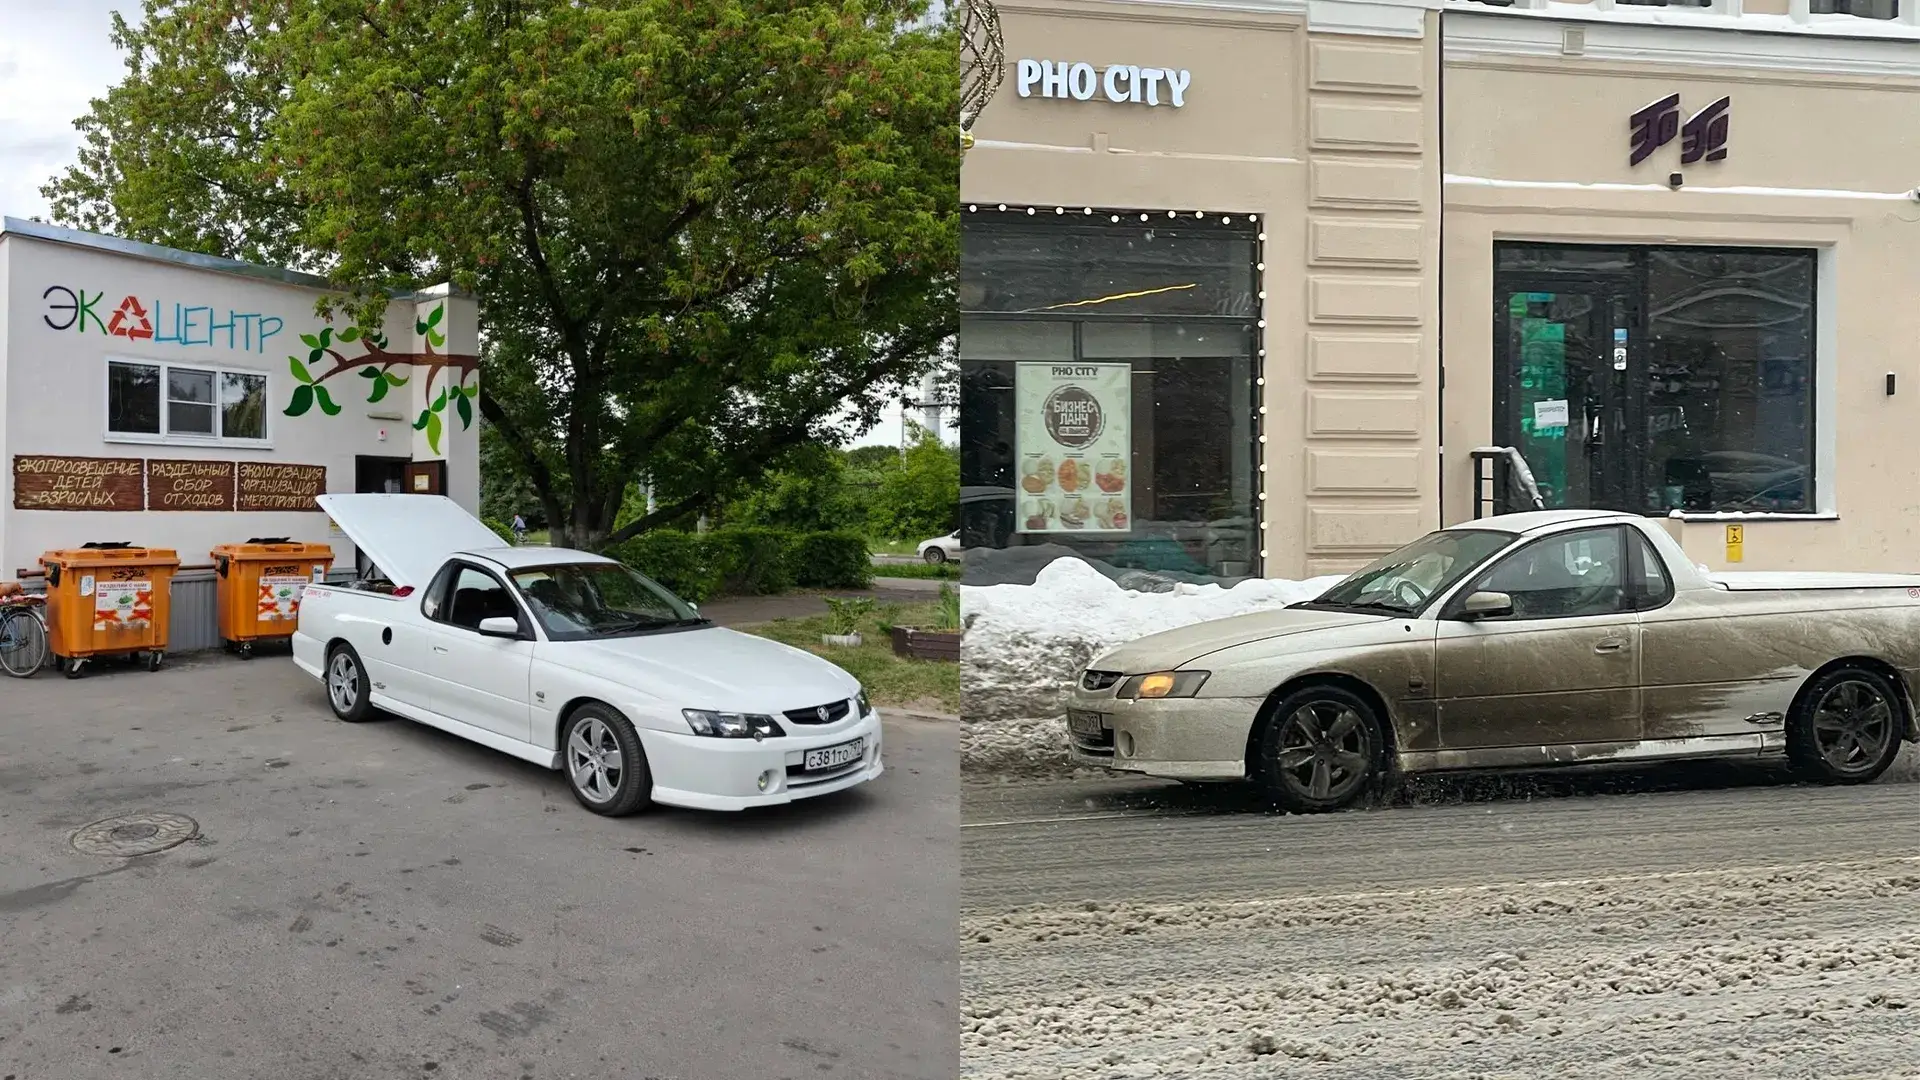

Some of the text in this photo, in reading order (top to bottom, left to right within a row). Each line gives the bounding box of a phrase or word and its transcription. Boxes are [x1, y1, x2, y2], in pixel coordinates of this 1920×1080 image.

[1017, 59, 1191, 108] PHO CITY
[1051, 366, 1099, 376] PHO CITY
[1053, 400, 1095, 413] БИЗНЕС
[1059, 412, 1089, 425] ЛАНЧ
[17, 459, 141, 476] ЭКОПРОСВЕЩЕНИЕ
[151, 463, 231, 478] РАЗДЕЛЬНЫЙ
[239, 464, 323, 480] ЭКОЛОГИЗАЦИЯ
[53, 475, 103, 490] ДЕТЕЙ
[173, 479, 213, 491] СБОР
[40, 490, 116, 506] ВЗРОСЛЫХ
[163, 493, 225, 506] ОТХОДОВ
